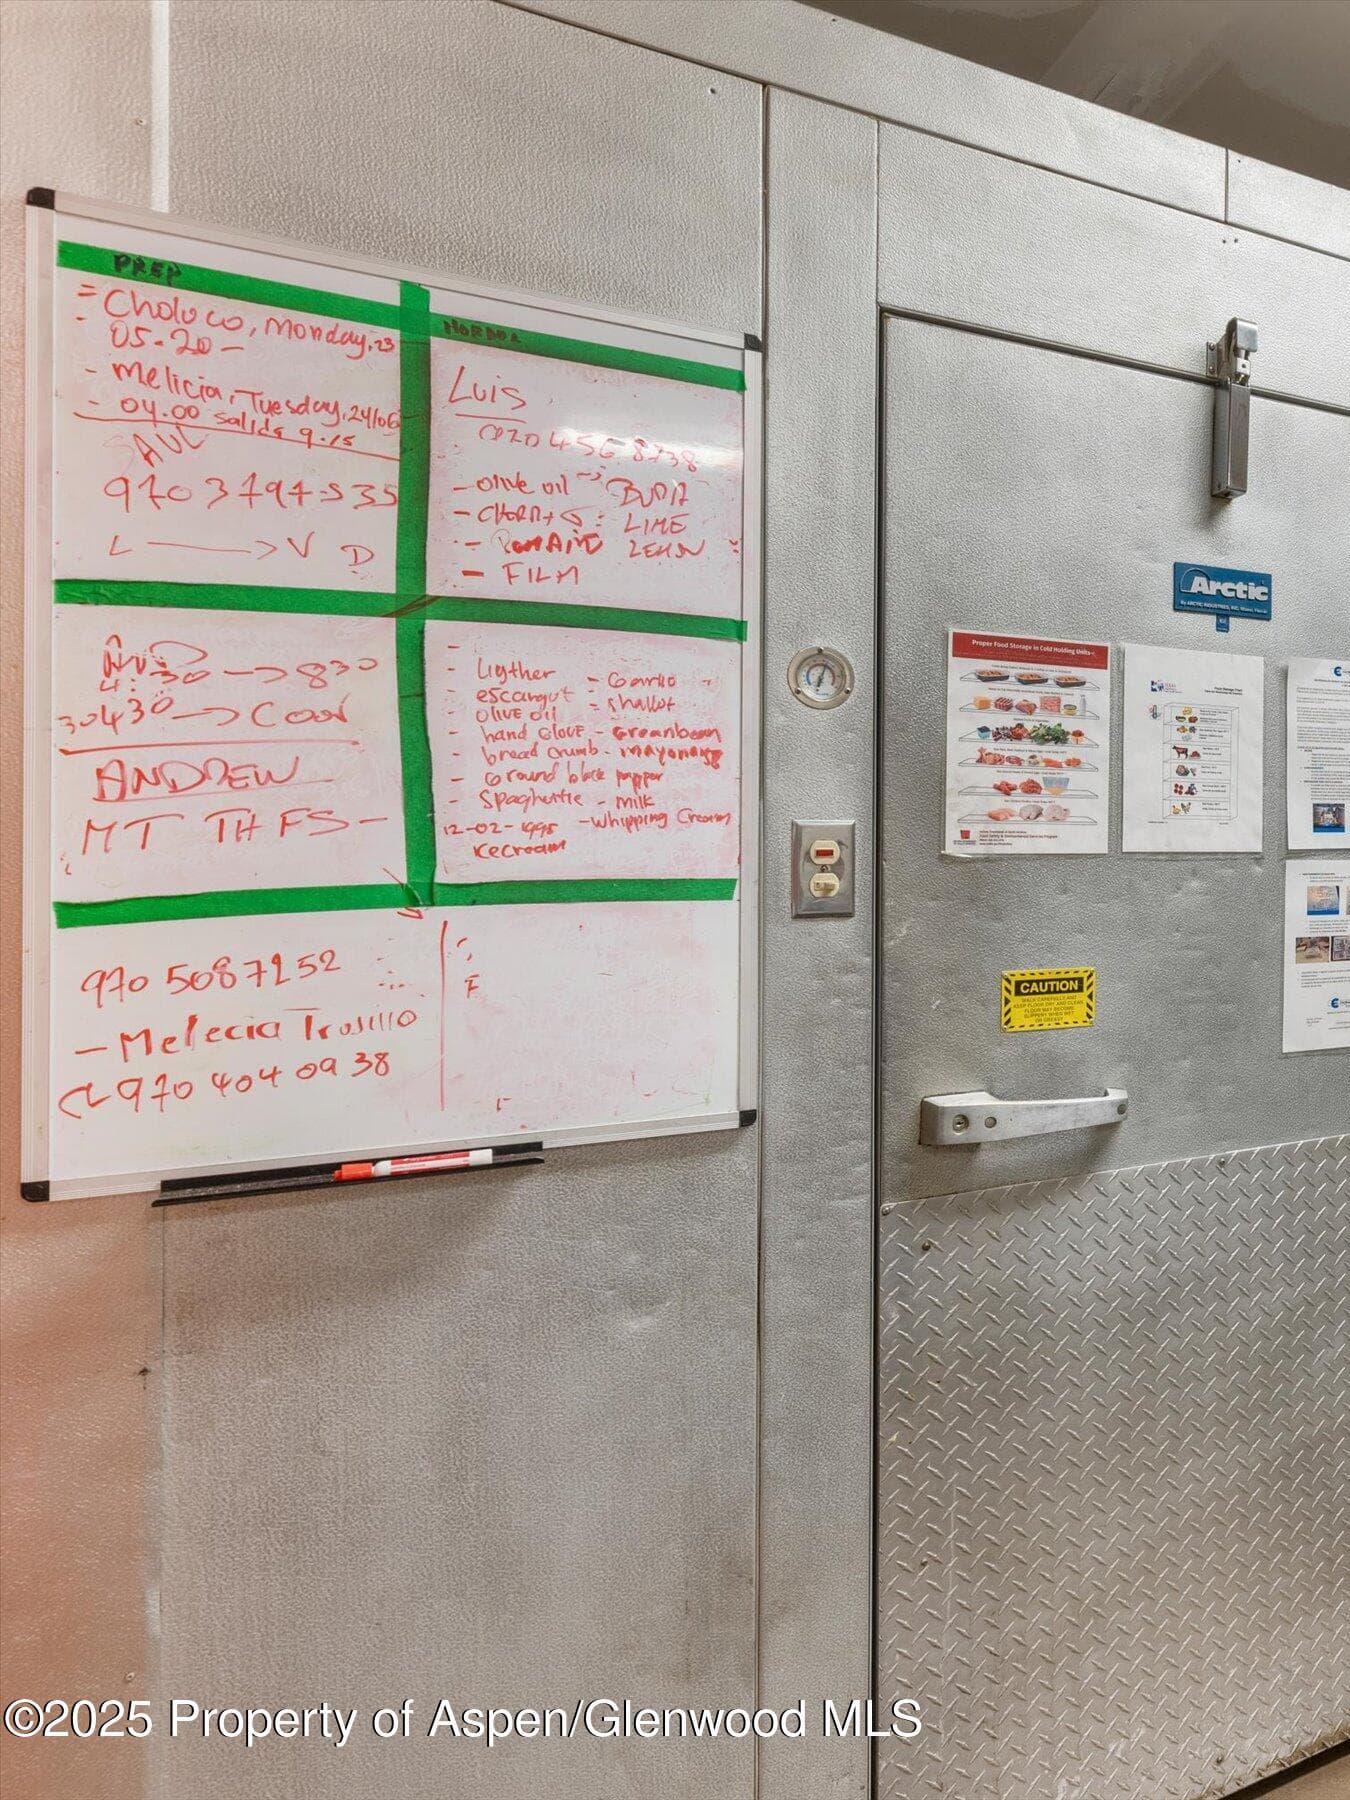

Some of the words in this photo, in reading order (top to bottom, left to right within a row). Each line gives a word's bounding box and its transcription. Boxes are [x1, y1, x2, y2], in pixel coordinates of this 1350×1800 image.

[502, 562, 580, 586] FILM
[1190, 575, 1269, 601] Arctic
[972, 639, 993, 649] Proper
[993, 641, 1009, 649] Food
[1020, 980, 1079, 994] CAUTION
